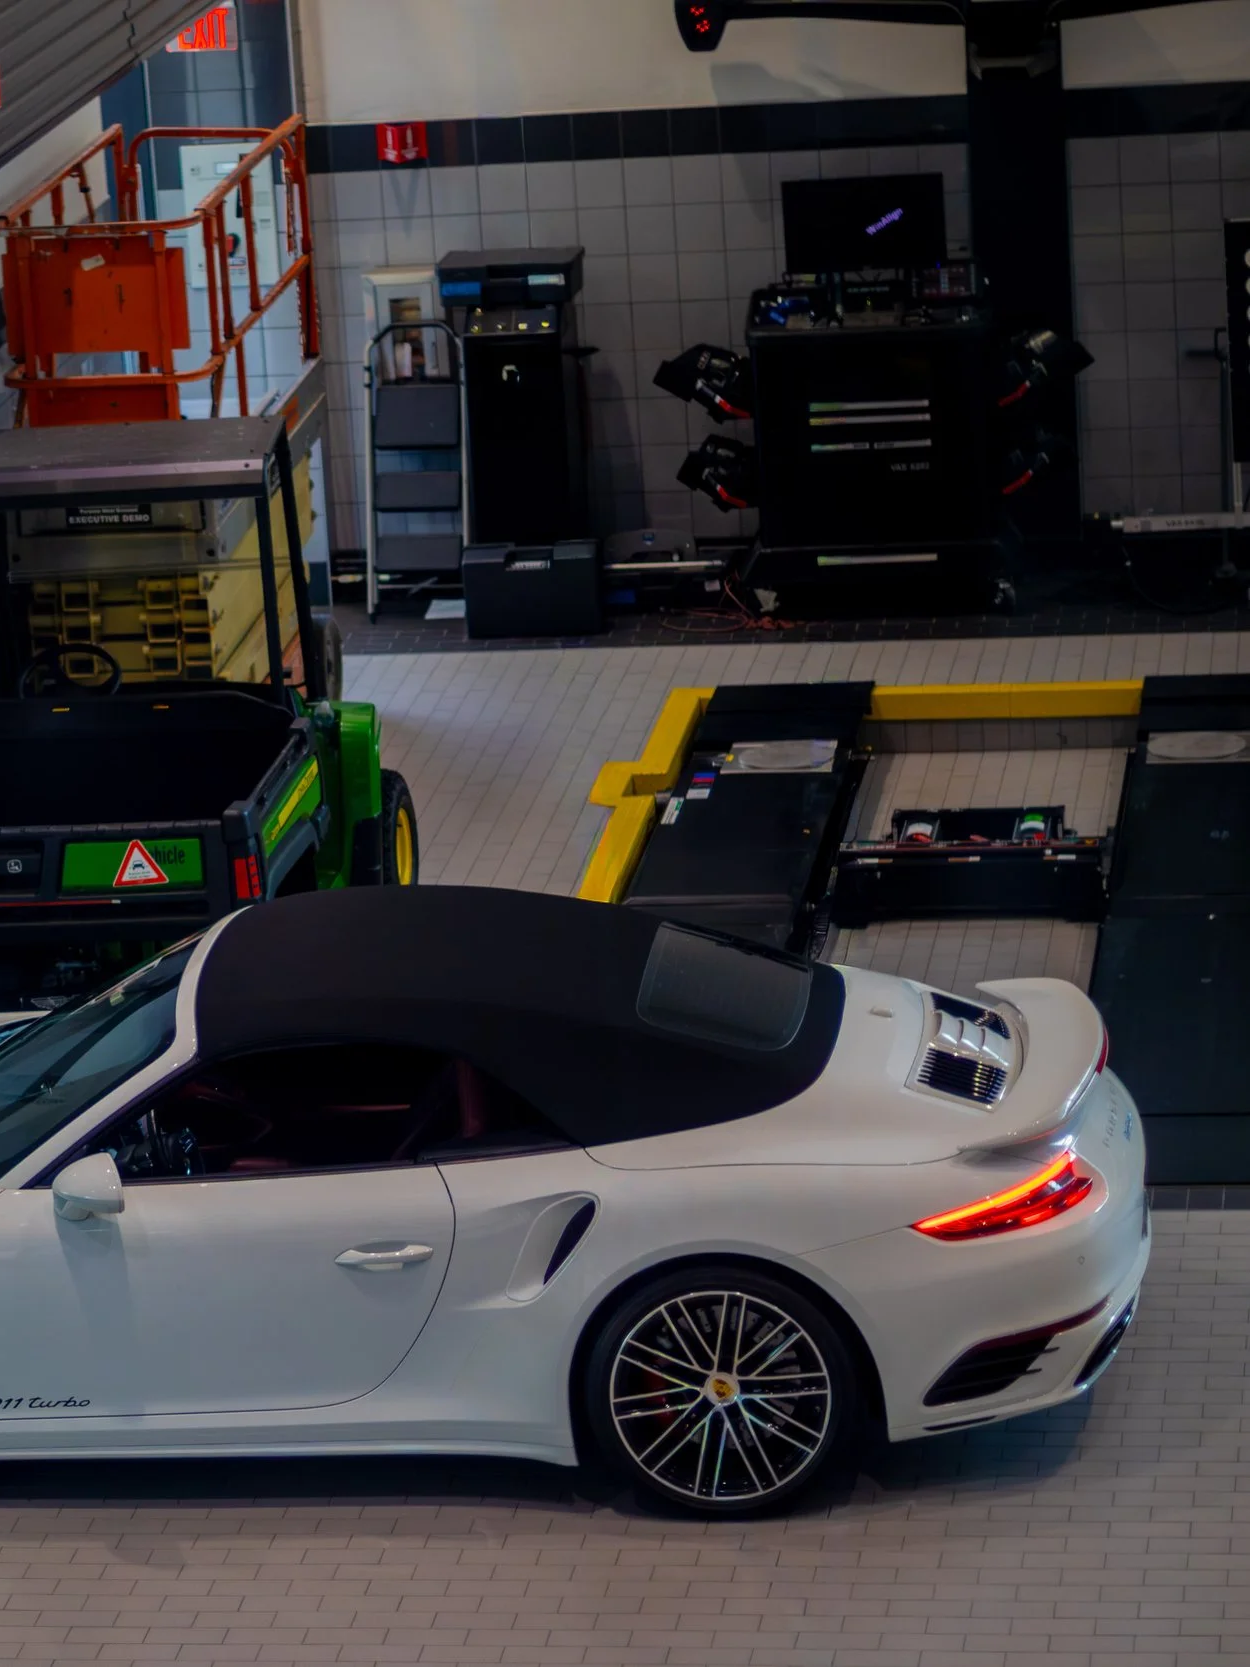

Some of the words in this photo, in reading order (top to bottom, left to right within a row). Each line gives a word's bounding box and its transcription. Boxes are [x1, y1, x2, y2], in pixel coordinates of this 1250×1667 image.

[865, 207, 904, 236] WinAlign
[68, 514, 120, 524] EXECUTIVE
[121, 513, 150, 523] DEMO
[151, 845, 186, 865] hicle
